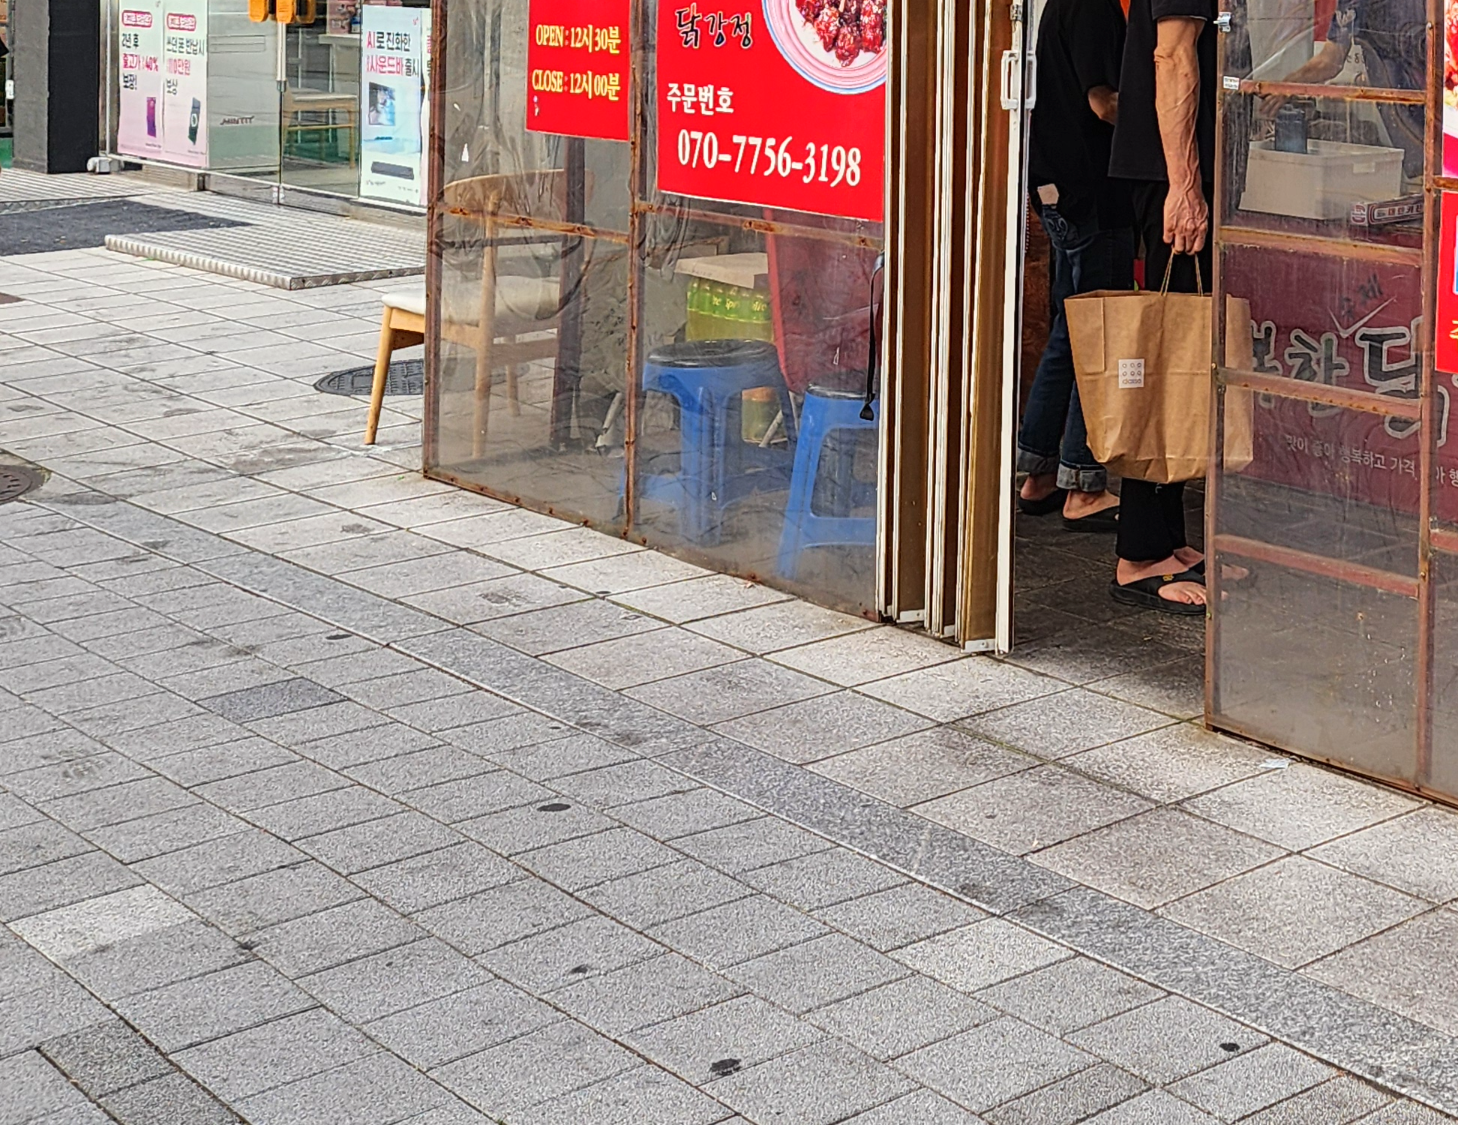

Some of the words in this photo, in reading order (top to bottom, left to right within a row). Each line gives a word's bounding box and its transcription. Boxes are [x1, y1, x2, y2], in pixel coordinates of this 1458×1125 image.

[570, 24, 593, 53] 12시
[594, 26, 621, 54] 30분
[675, 2, 753, 49] 닭강정
[569, 70, 593, 100] 12시
[593, 73, 621, 101] 00분
[666, 82, 735, 116] 주문번호
[677, 129, 862, 188] 070-7756-3198
